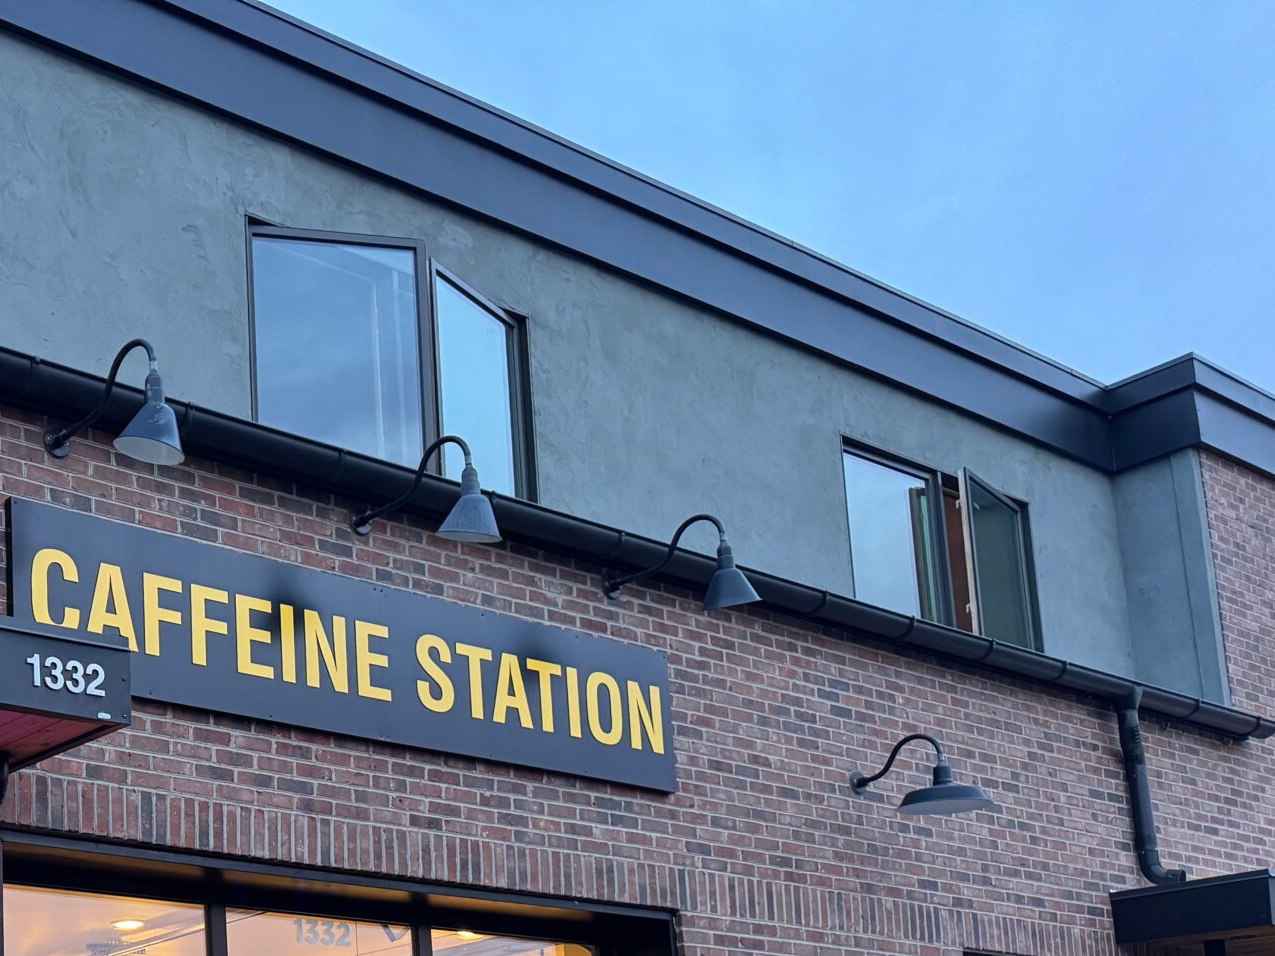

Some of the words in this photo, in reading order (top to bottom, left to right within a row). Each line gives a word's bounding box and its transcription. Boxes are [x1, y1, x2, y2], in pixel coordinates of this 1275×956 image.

[31, 548, 392, 702] CAFFEINE
[416, 634, 665, 755] STATION
[26, 653, 106, 698] 1332
[294, 918, 351, 947] 1332
